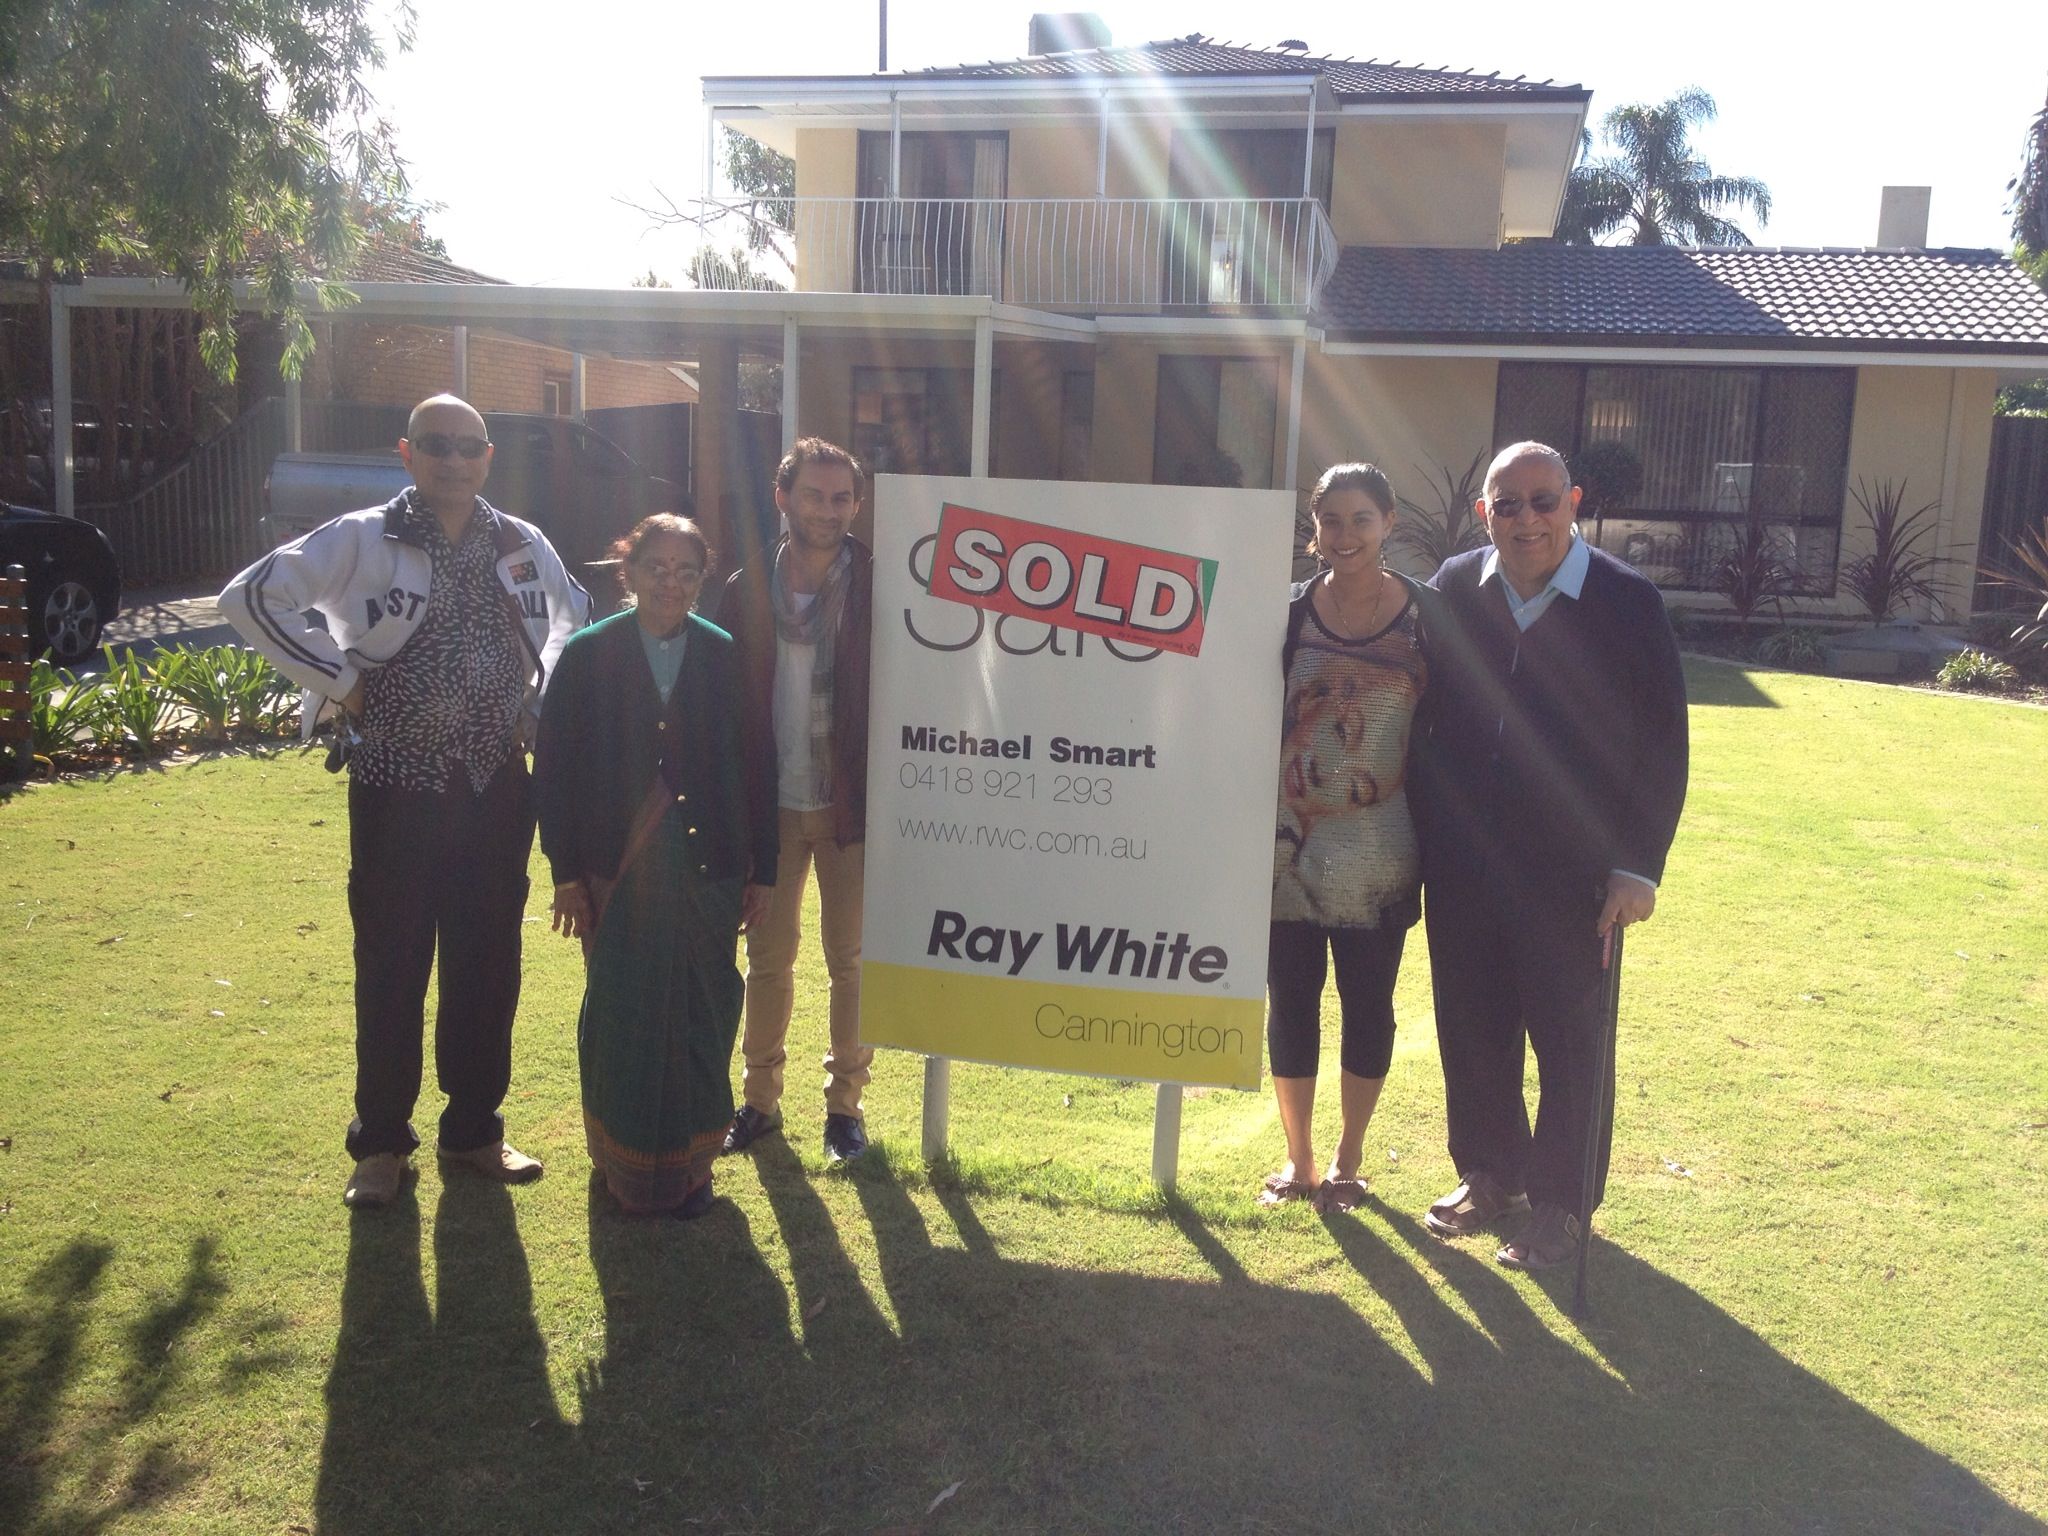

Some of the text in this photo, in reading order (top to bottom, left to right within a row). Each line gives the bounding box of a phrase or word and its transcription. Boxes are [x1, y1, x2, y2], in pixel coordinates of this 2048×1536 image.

[947, 528, 1199, 633] SOLD
[365, 587, 426, 630] AST
[901, 725, 1156, 769] Michael Smart
[899, 762, 1113, 806] 0418 921 293
[898, 818, 1148, 861] www.rwc.com.au
[927, 909, 1229, 984] Ray White
[1035, 1003, 1244, 1058] Cannington
